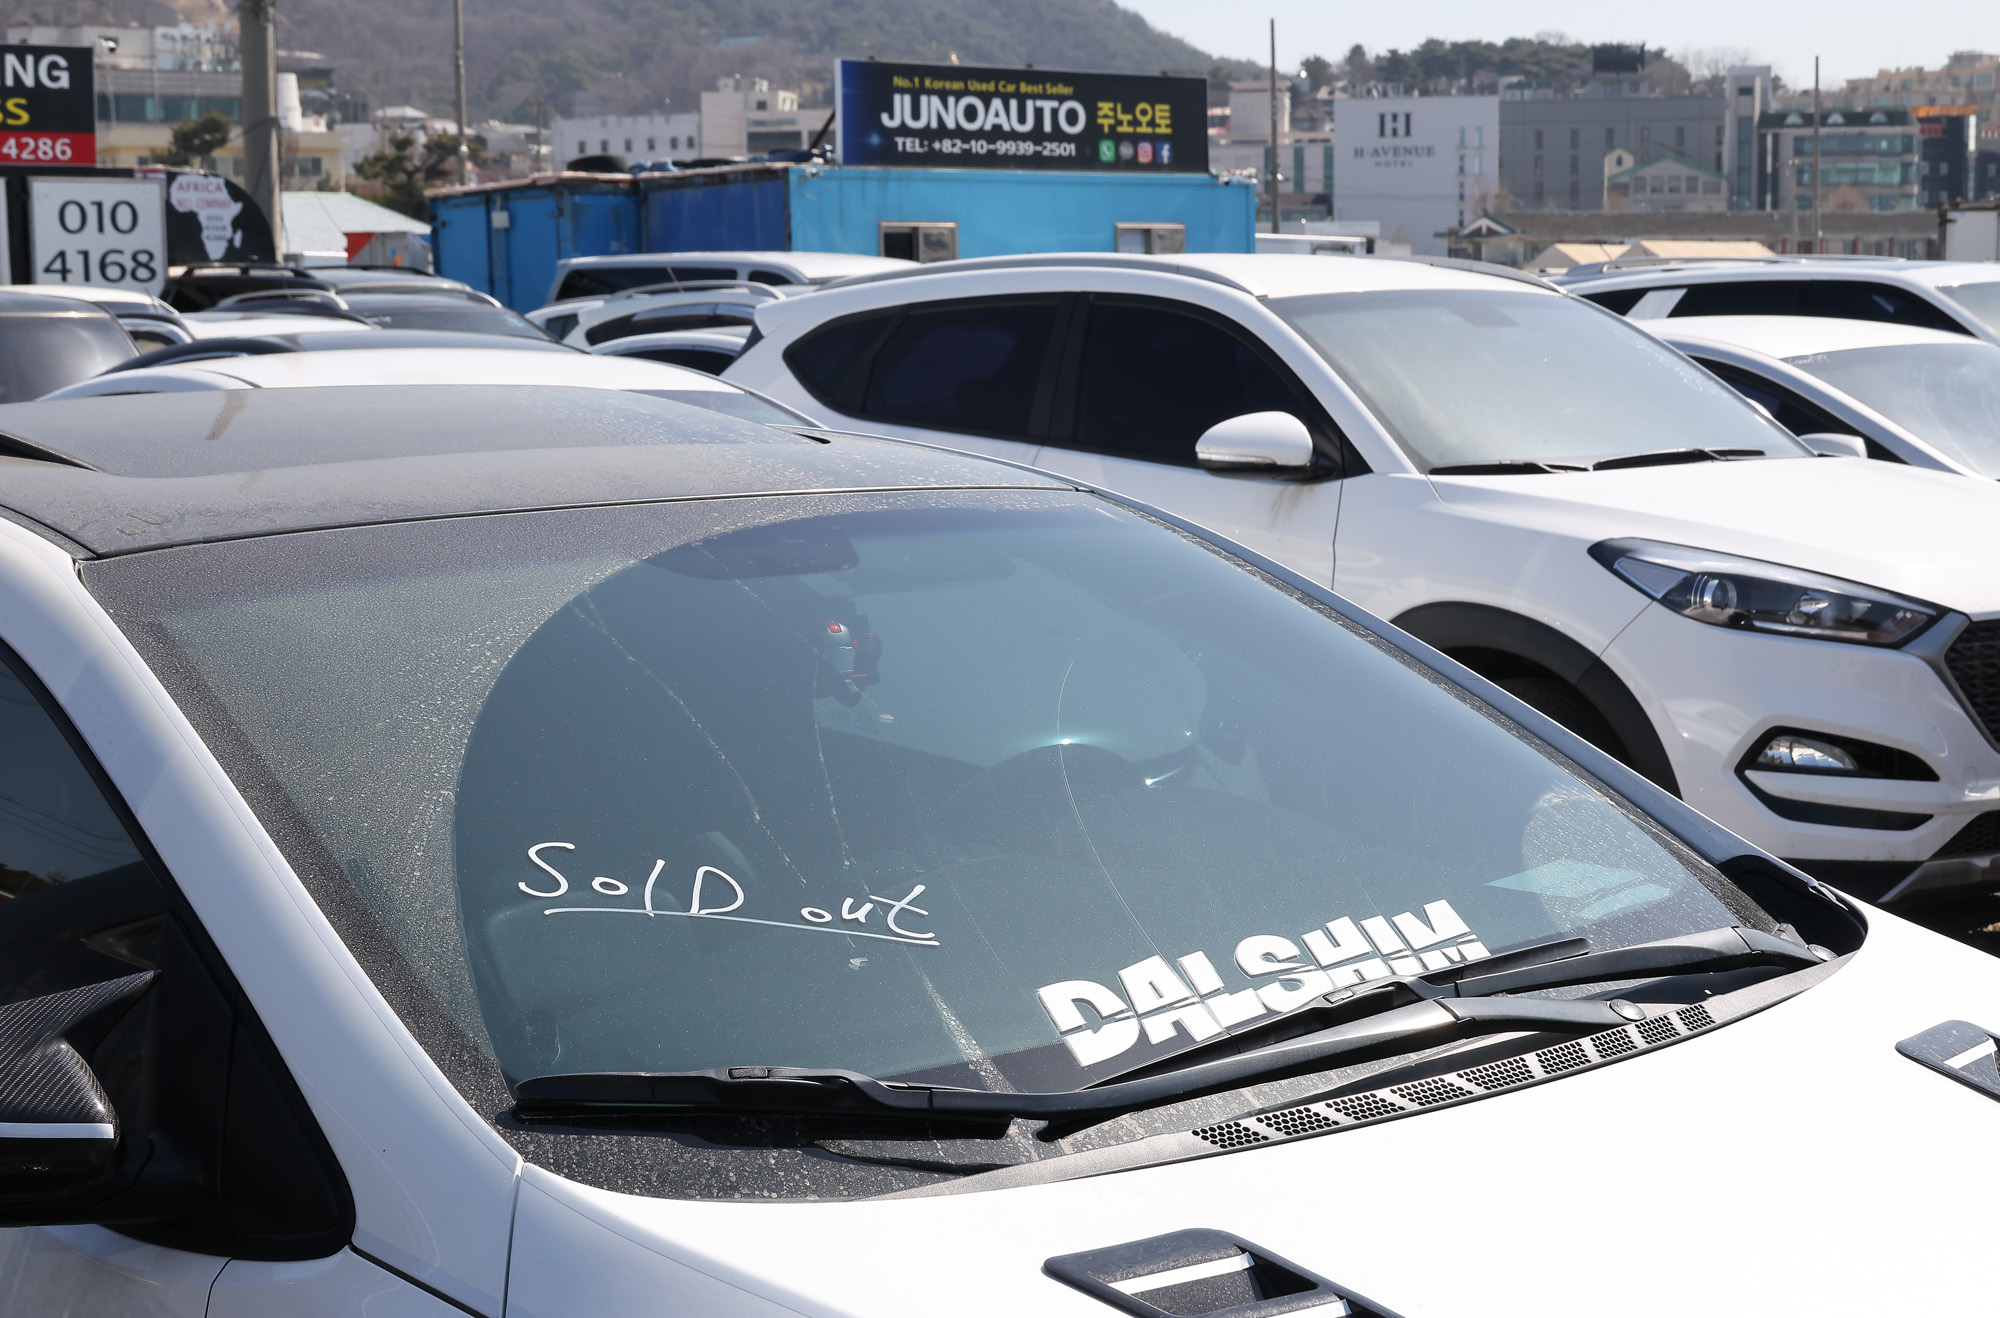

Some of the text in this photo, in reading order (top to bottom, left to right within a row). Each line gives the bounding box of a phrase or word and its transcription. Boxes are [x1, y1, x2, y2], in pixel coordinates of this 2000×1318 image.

[893, 76, 1075, 96] No.1 Korean Used Car Best Seller
[0, 97, 30, 126] S
[880, 93, 1087, 135] JUNOAUTO
[1097, 101, 1172, 134] 주노오토
[1, 136, 72, 161] 4286
[894, 137, 1076, 157] TEL: +82-10-9939-2501
[177, 181, 223, 193] AFRICA
[58, 200, 138, 234] 010
[43, 249, 156, 283] 4168
[800, 884, 935, 938] out
[1037, 899, 1491, 1067] DALSHIM
